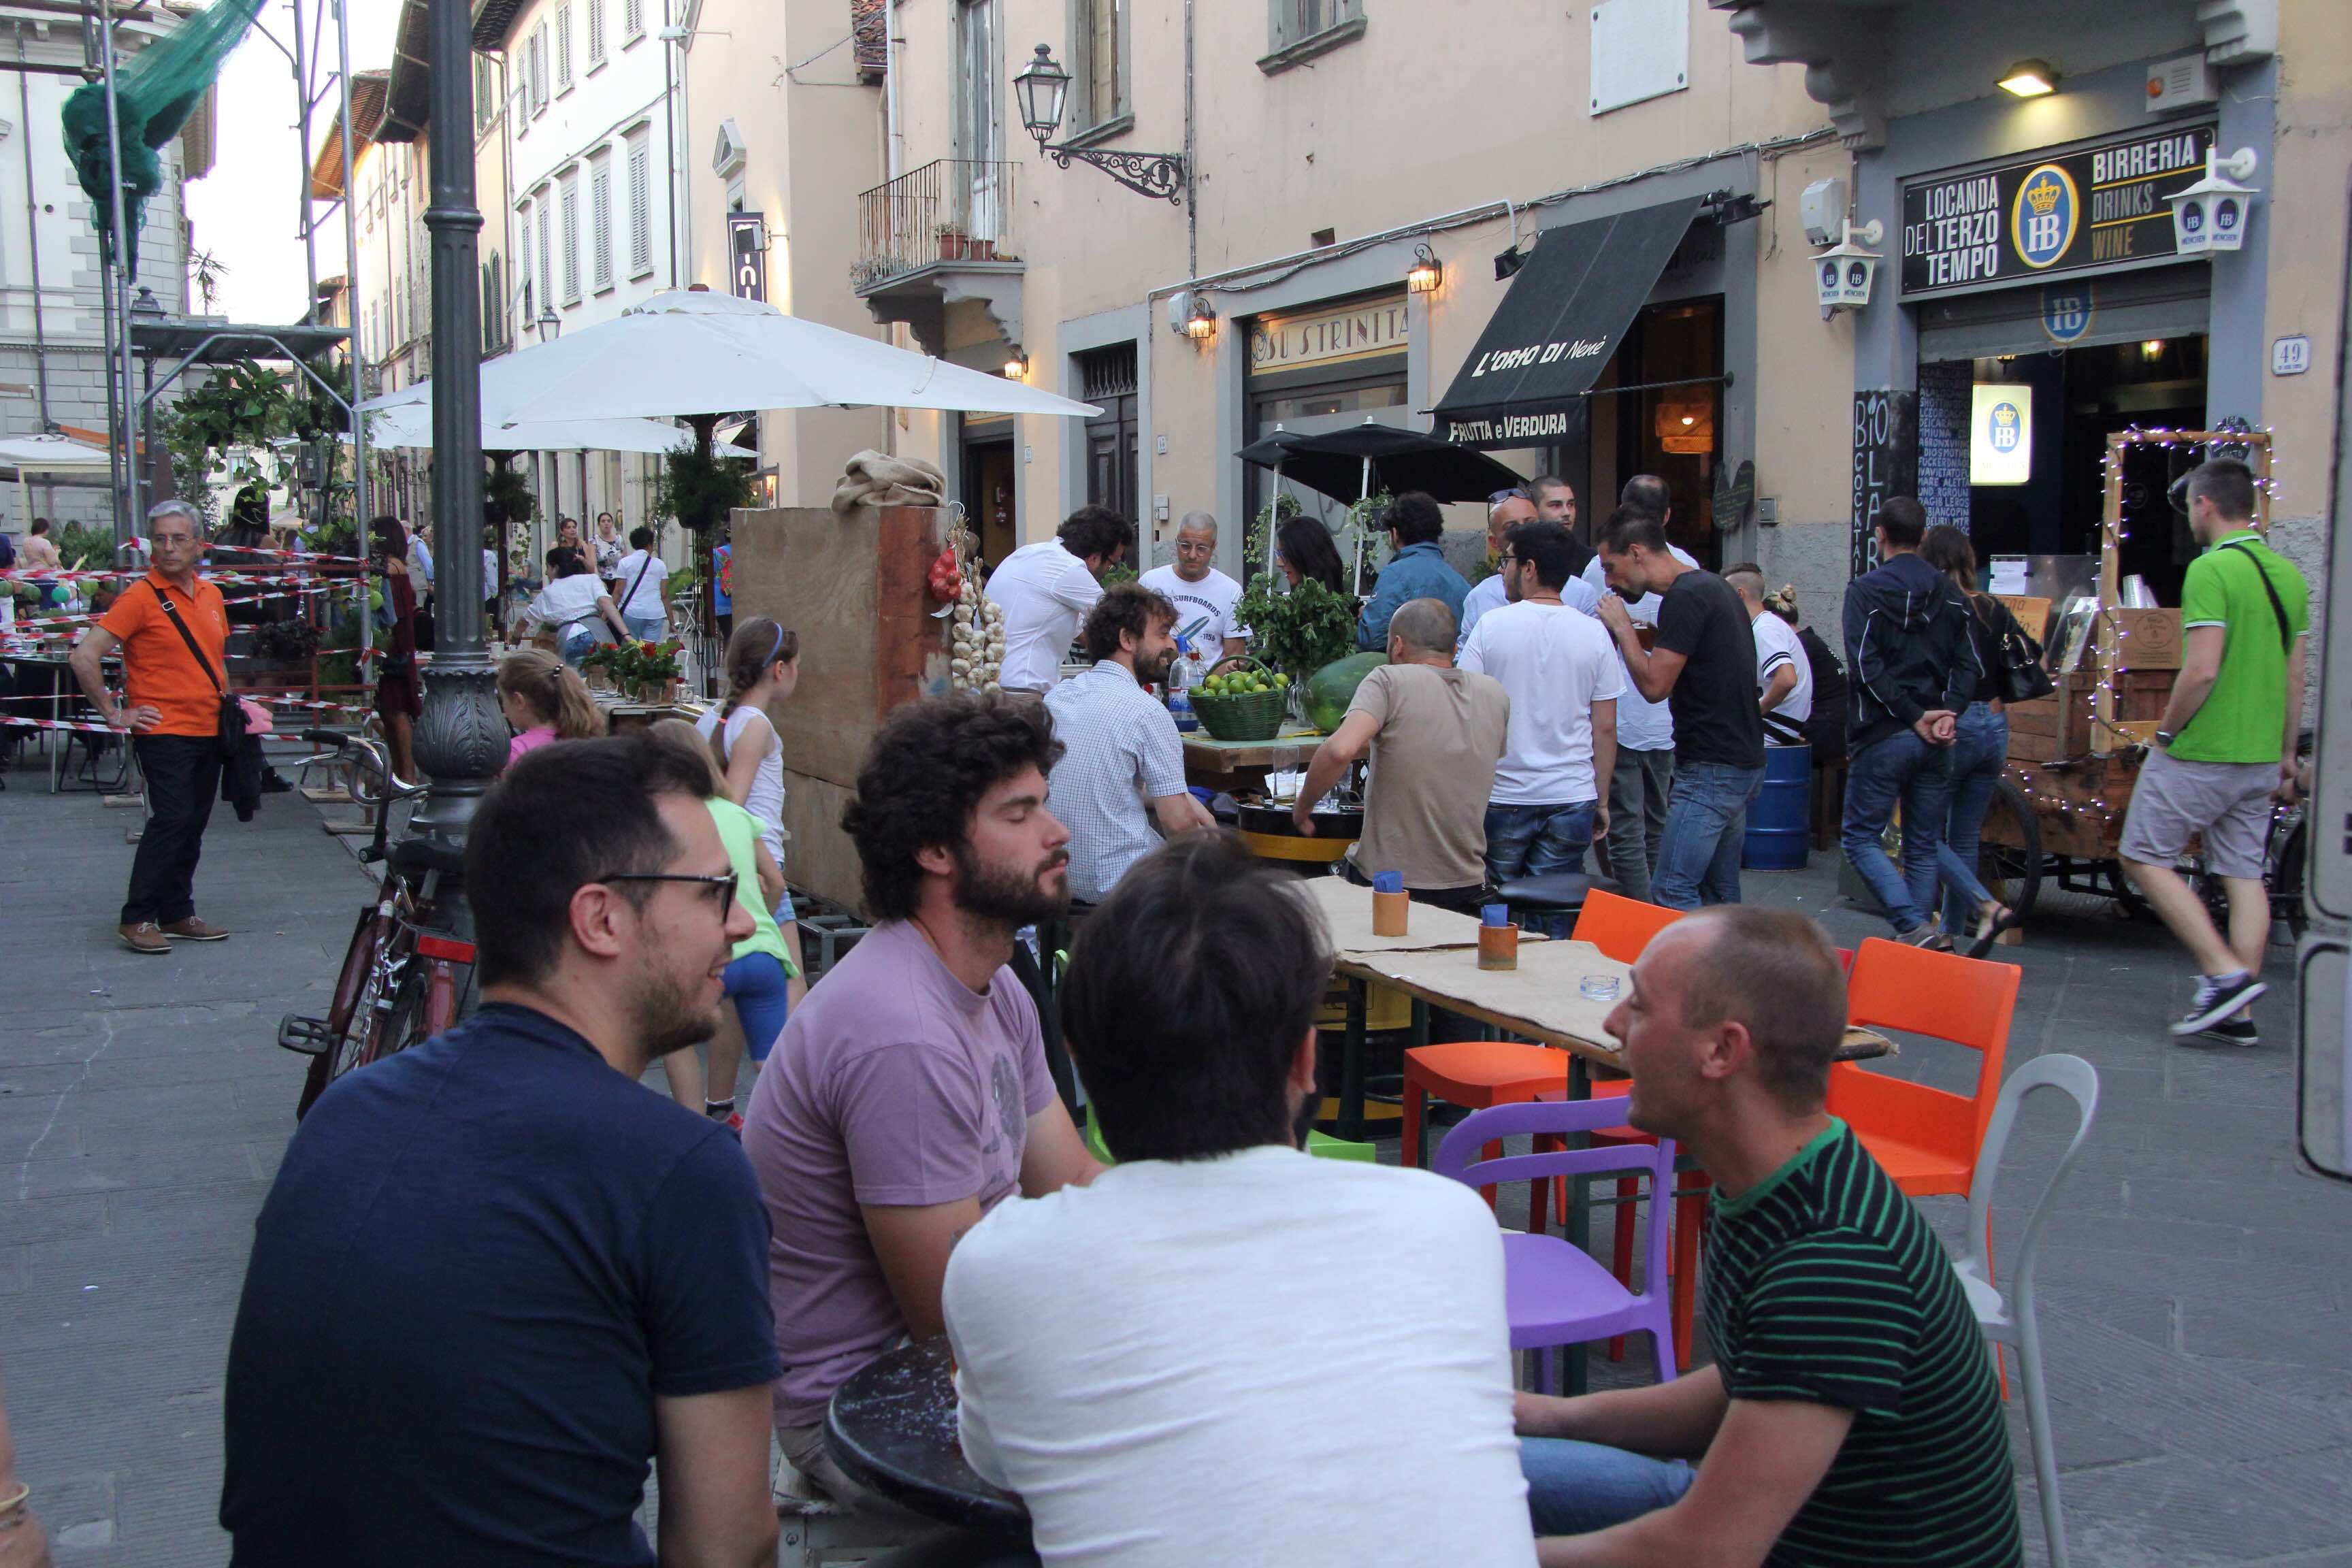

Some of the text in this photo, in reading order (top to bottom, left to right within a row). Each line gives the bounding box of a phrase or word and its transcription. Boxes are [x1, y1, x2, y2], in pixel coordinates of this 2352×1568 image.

[2093, 135, 2195, 184] BIRRERIA
[1925, 176, 1999, 220] LOCANDA
[2092, 182, 2153, 223] DRINKS
[1906, 210, 1998, 257] DEL TERZO
[2027, 214, 2060, 253] HB
[2092, 225, 2134, 261] WINE
[1926, 244, 1998, 285] TEMPO
[1539, 342, 1567, 364] DI
[2280, 343, 2300, 363] 49
[1448, 413, 1567, 442] FRUTTA e VERDURA
[1173, 595, 1221, 617] SURFBOARDS
